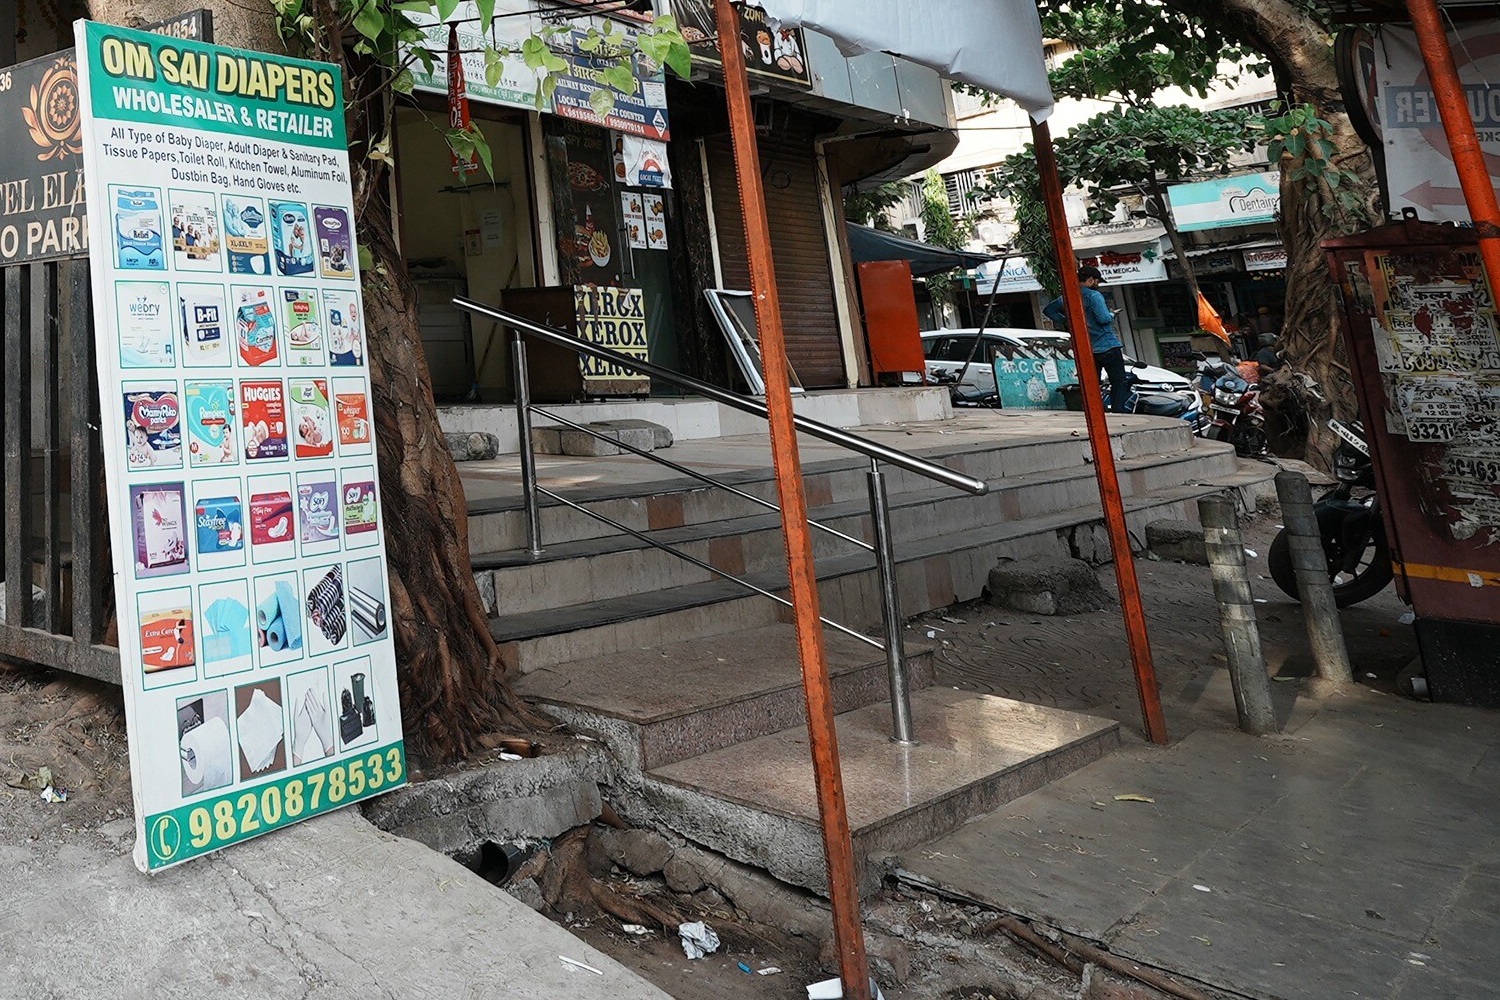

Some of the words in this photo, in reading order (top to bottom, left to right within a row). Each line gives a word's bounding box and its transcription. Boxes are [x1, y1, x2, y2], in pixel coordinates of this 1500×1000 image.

[101, 37, 154, 80] OM
[159, 47, 208, 90] SAI
[216, 55, 335, 109] DIAPERS
[556, 78, 579, 90] AILWAY
[112, 86, 236, 127] WHOLESALER
[240, 107, 253, 127] &
[256, 109, 334, 139] RETAILER
[557, 94, 578, 106] LOCAL
[620, 109, 645, 123] COUNTER
[110, 127, 124, 140] All
[128, 128, 152, 146] Type
[155, 132, 166, 144] of
[168, 132, 192, 150] Baby
[195, 136, 226, 154] Diaper,
[227, 140, 251, 155] Adult
[253, 143, 281, 161] Diaper
[281, 147, 288, 159] &
[289, 148, 321, 166] Sanitary
[322, 154, 340, 169] Pad,
[102, 143, 138, 159] Tissue
[207, 155, 227, 171] Roll,
[229, 157, 261, 173] Kitchen
[263, 161, 290, 178] Towel,
[291, 165, 331, 181] Aluminum
[332, 168, 348, 185] Foil,
[171, 168, 208, 183] Dustbin
[211, 171, 231, 188] Bag,
[233, 174, 255, 189] Hand
[256, 178, 285, 193] Gloves
[287, 182, 301, 195] etc.
[1113, 266, 1140, 275] MEDICAL
[575, 291, 644, 318] XEROX
[576, 320, 647, 346] XEROX
[243, 387, 281, 402] HUGGIES
[187, 747, 404, 849] 9820878533
